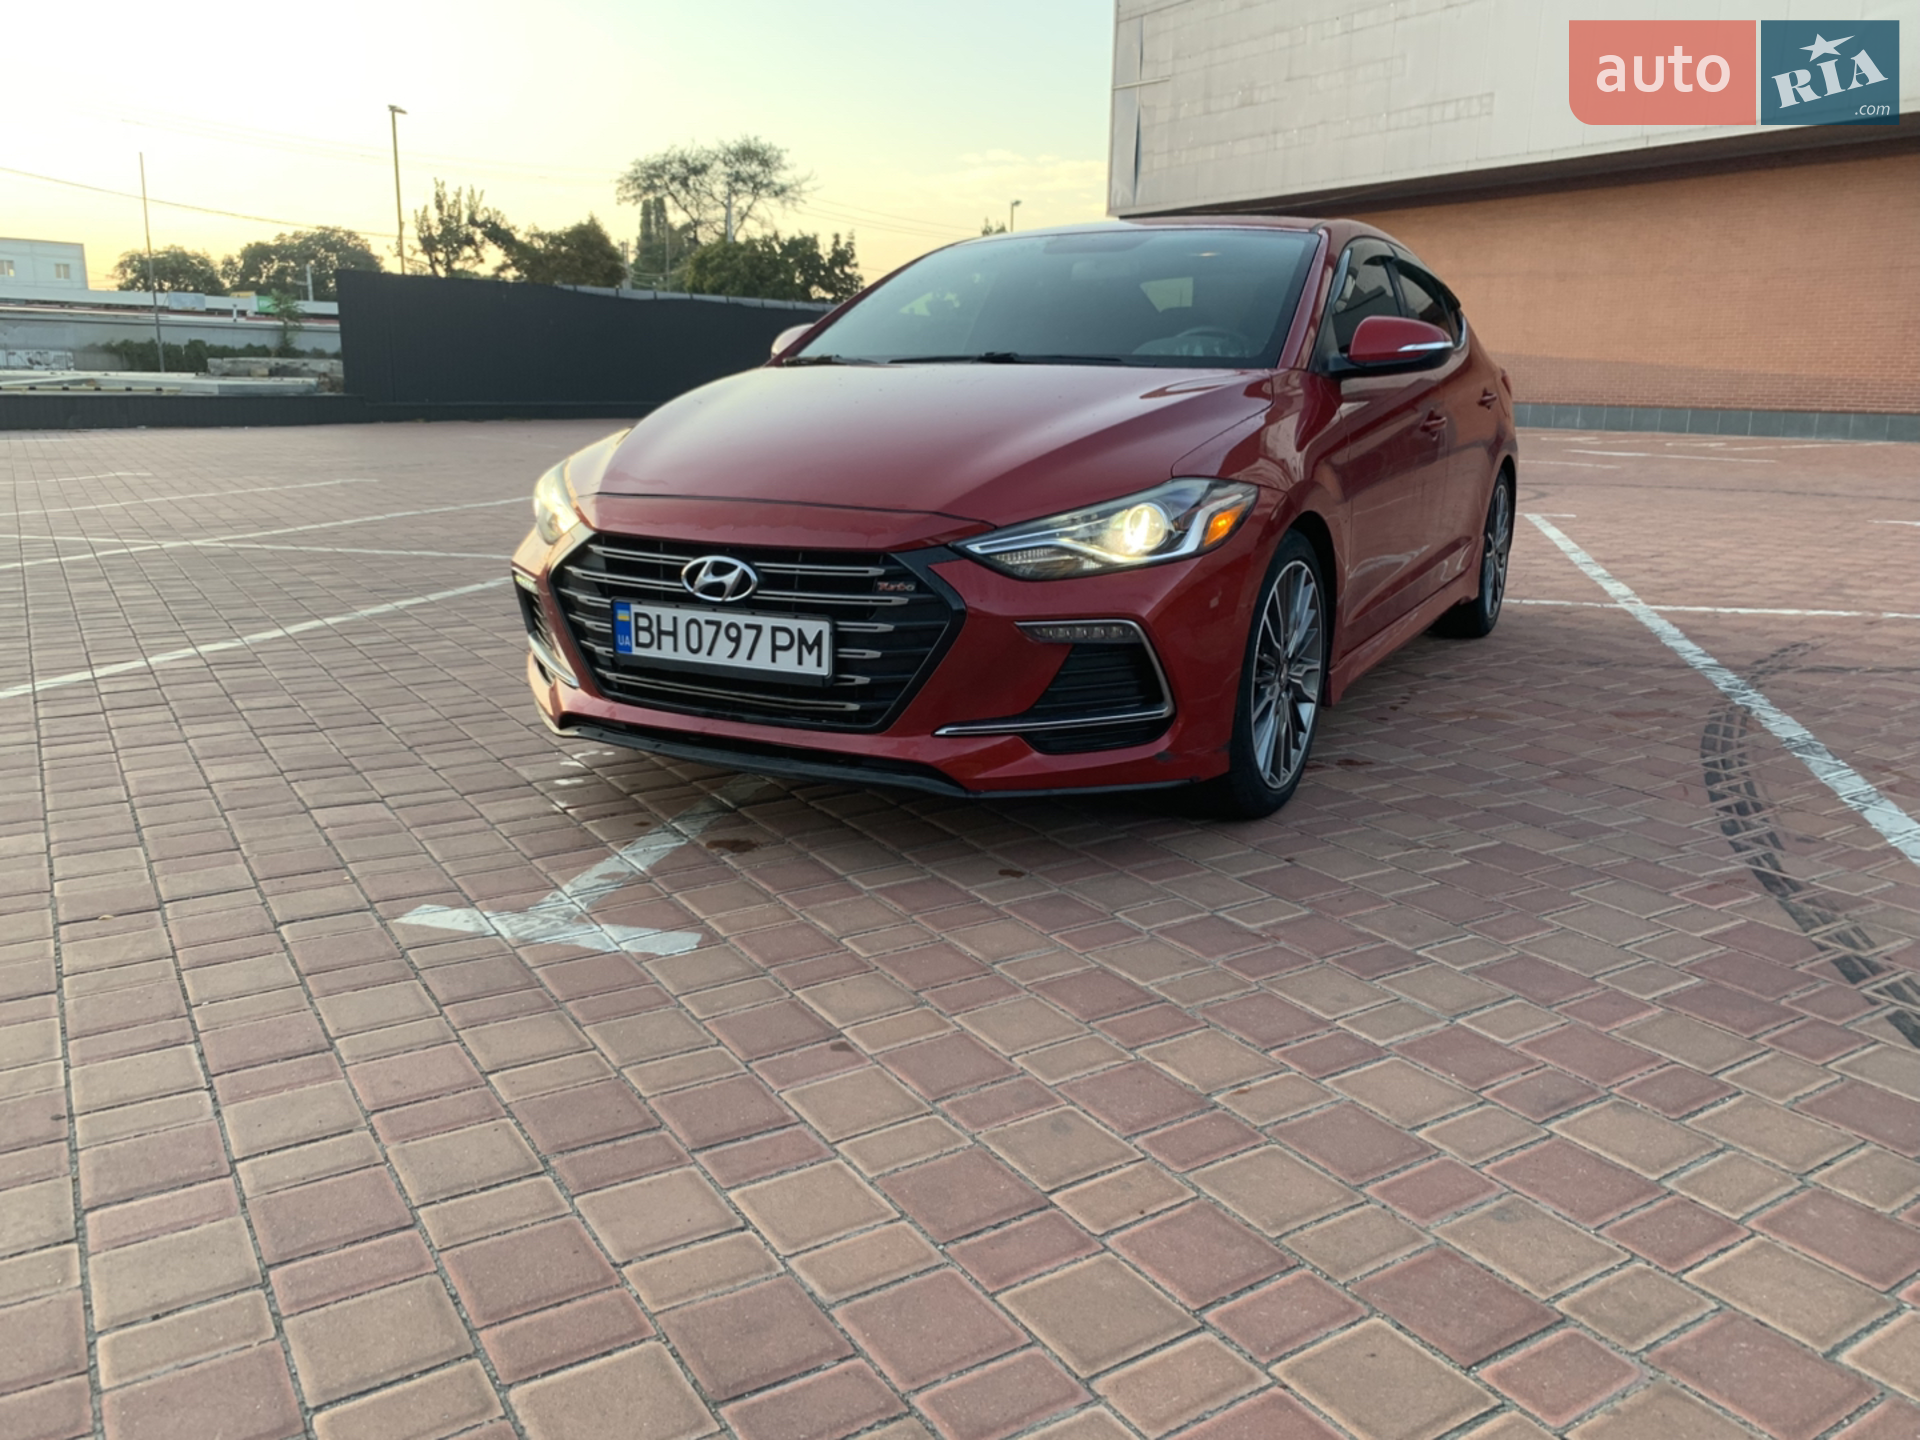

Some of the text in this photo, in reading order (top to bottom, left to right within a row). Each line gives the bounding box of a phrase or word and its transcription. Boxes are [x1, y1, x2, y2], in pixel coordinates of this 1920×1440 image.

[617, 634, 631, 647] UA
[634, 612, 824, 668] BH 0797 PM
